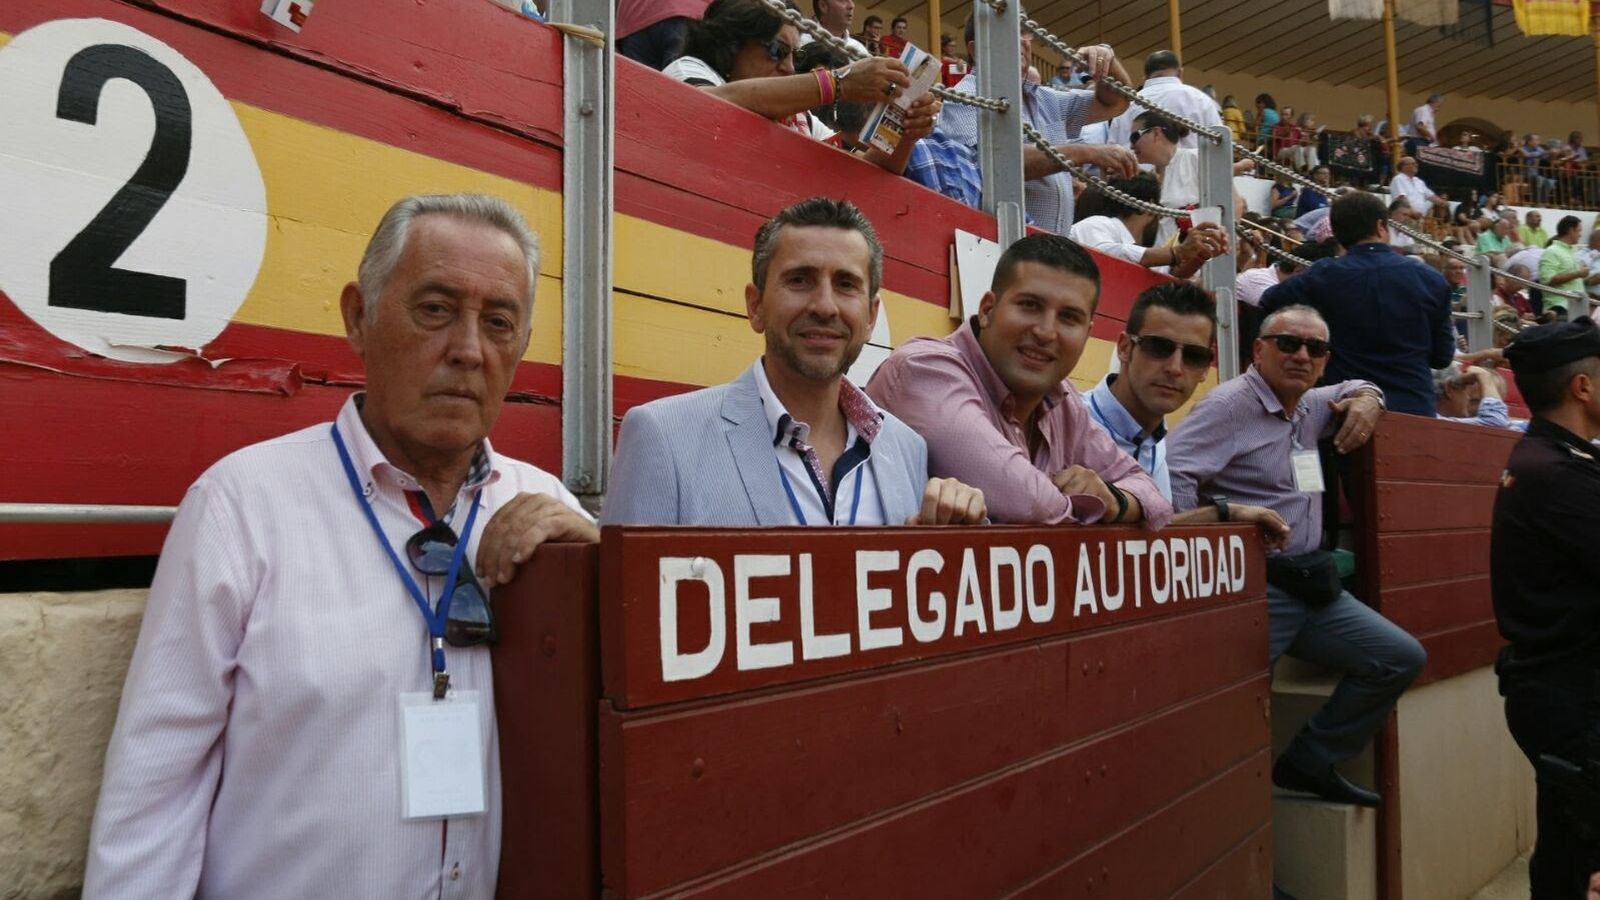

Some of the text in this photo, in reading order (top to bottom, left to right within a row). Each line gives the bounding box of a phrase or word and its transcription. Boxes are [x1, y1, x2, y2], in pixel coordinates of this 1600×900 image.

[48, 44, 192, 320] 2
[659, 534, 1246, 682] DELEGADO AUTORIDAD
